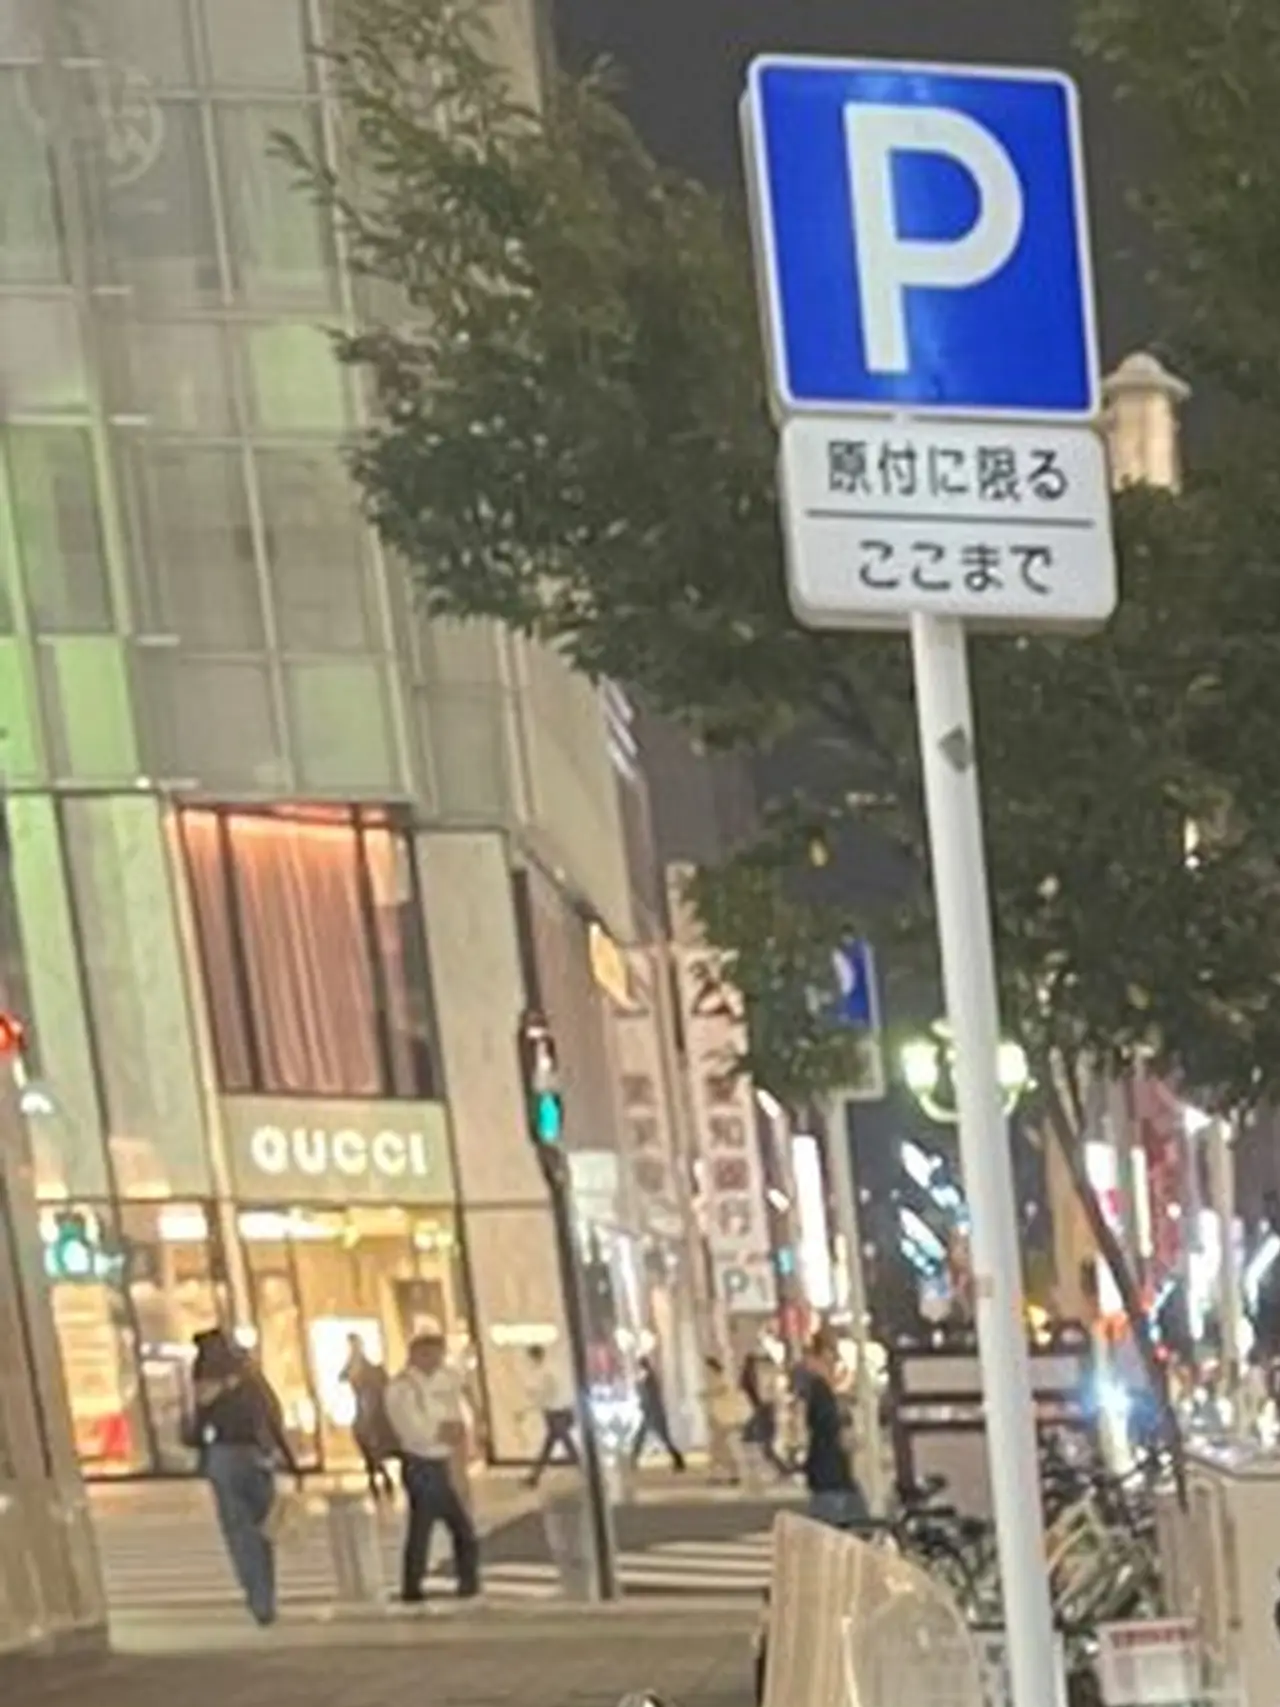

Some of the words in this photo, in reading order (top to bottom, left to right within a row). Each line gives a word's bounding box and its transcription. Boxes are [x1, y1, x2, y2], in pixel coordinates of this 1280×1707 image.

[843, 102, 1024, 374] P
[826, 439, 1070, 502] 原付に限る
[857, 538, 1056, 594] ここまで
[251, 1125, 428, 1177] GUCCI
